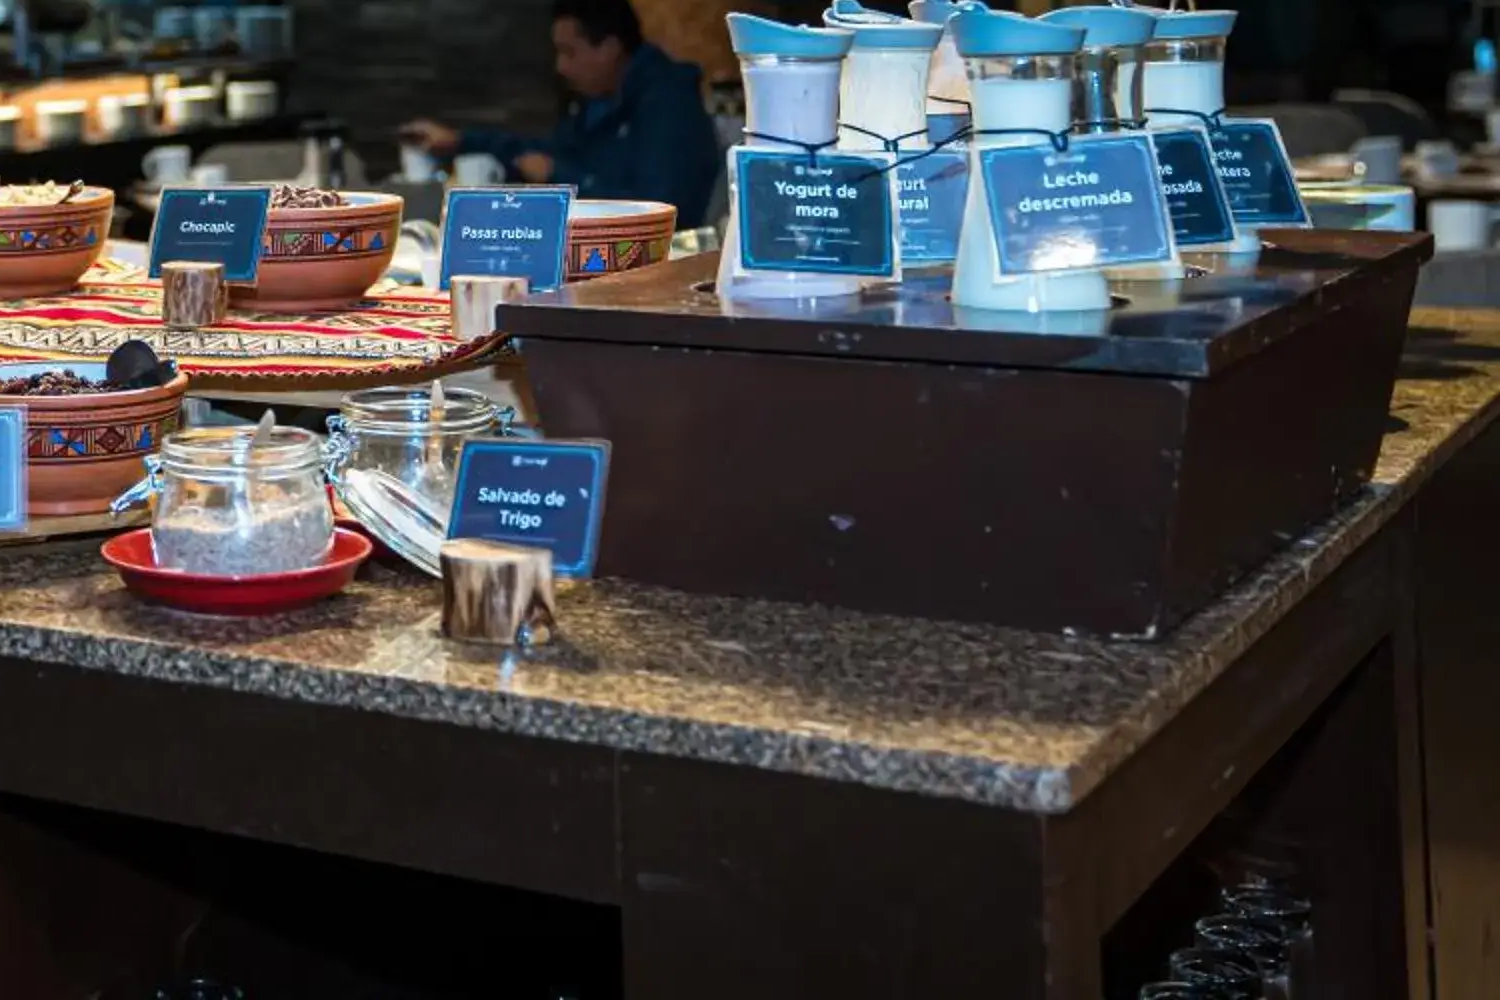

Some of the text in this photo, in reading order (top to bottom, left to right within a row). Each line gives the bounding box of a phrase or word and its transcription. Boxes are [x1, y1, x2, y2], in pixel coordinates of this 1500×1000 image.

[1043, 170, 1100, 189] Leche
[773, 180, 858, 199] Yogurt de
[899, 195, 929, 210] ural
[1018, 189, 1134, 213] descremada
[795, 203, 840, 219] mora
[179, 221, 236, 236] Chocapic
[461, 225, 543, 239] Pasas rubias
[477, 487, 566, 507] Salvado de
[500, 509, 543, 530] Trigo
